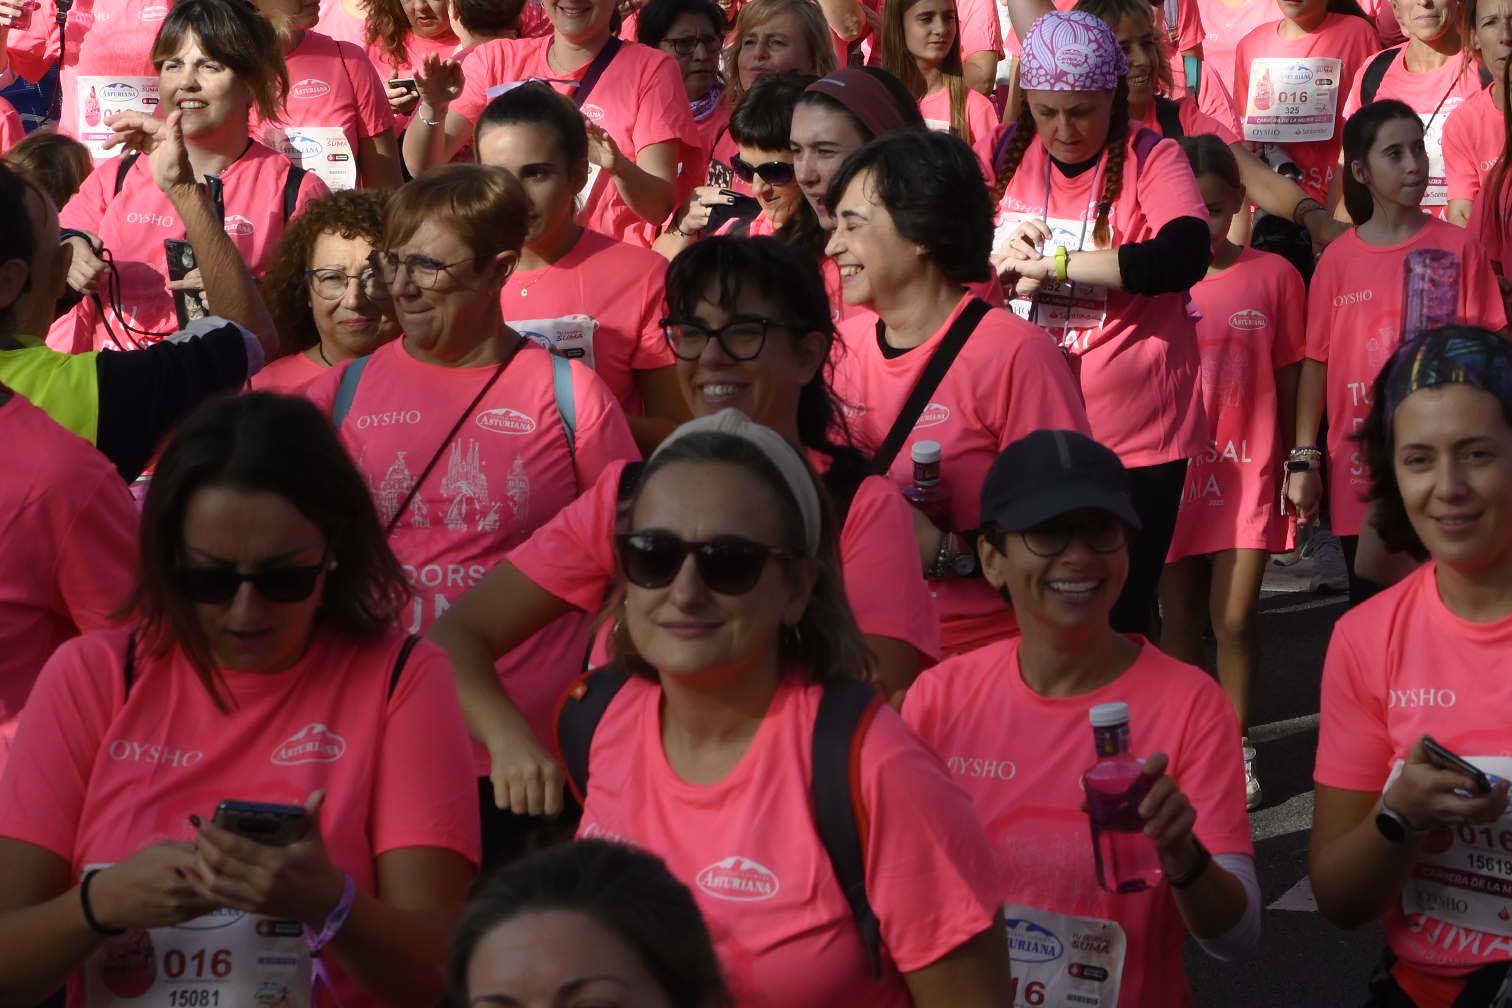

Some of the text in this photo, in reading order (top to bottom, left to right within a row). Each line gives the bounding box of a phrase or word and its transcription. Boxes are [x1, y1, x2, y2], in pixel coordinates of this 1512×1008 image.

[1278, 91, 1308, 103] 016
[1285, 106, 1300, 115] 325
[127, 212, 173, 228] OYSHO
[1334, 289, 1373, 307] OYSHO
[357, 409, 532, 432] OYSHO ASTURIANA
[110, 739, 203, 768] OYSHO
[703, 870, 771, 894] ASTURIANA
[1471, 877, 1485, 889] DE
[1486, 880, 1501, 891] LA
[1009, 940, 1057, 957] URIANA
[1072, 940, 1111, 954] SUMA
[163, 948, 232, 979] 016
[169, 989, 220, 1008] 15081
